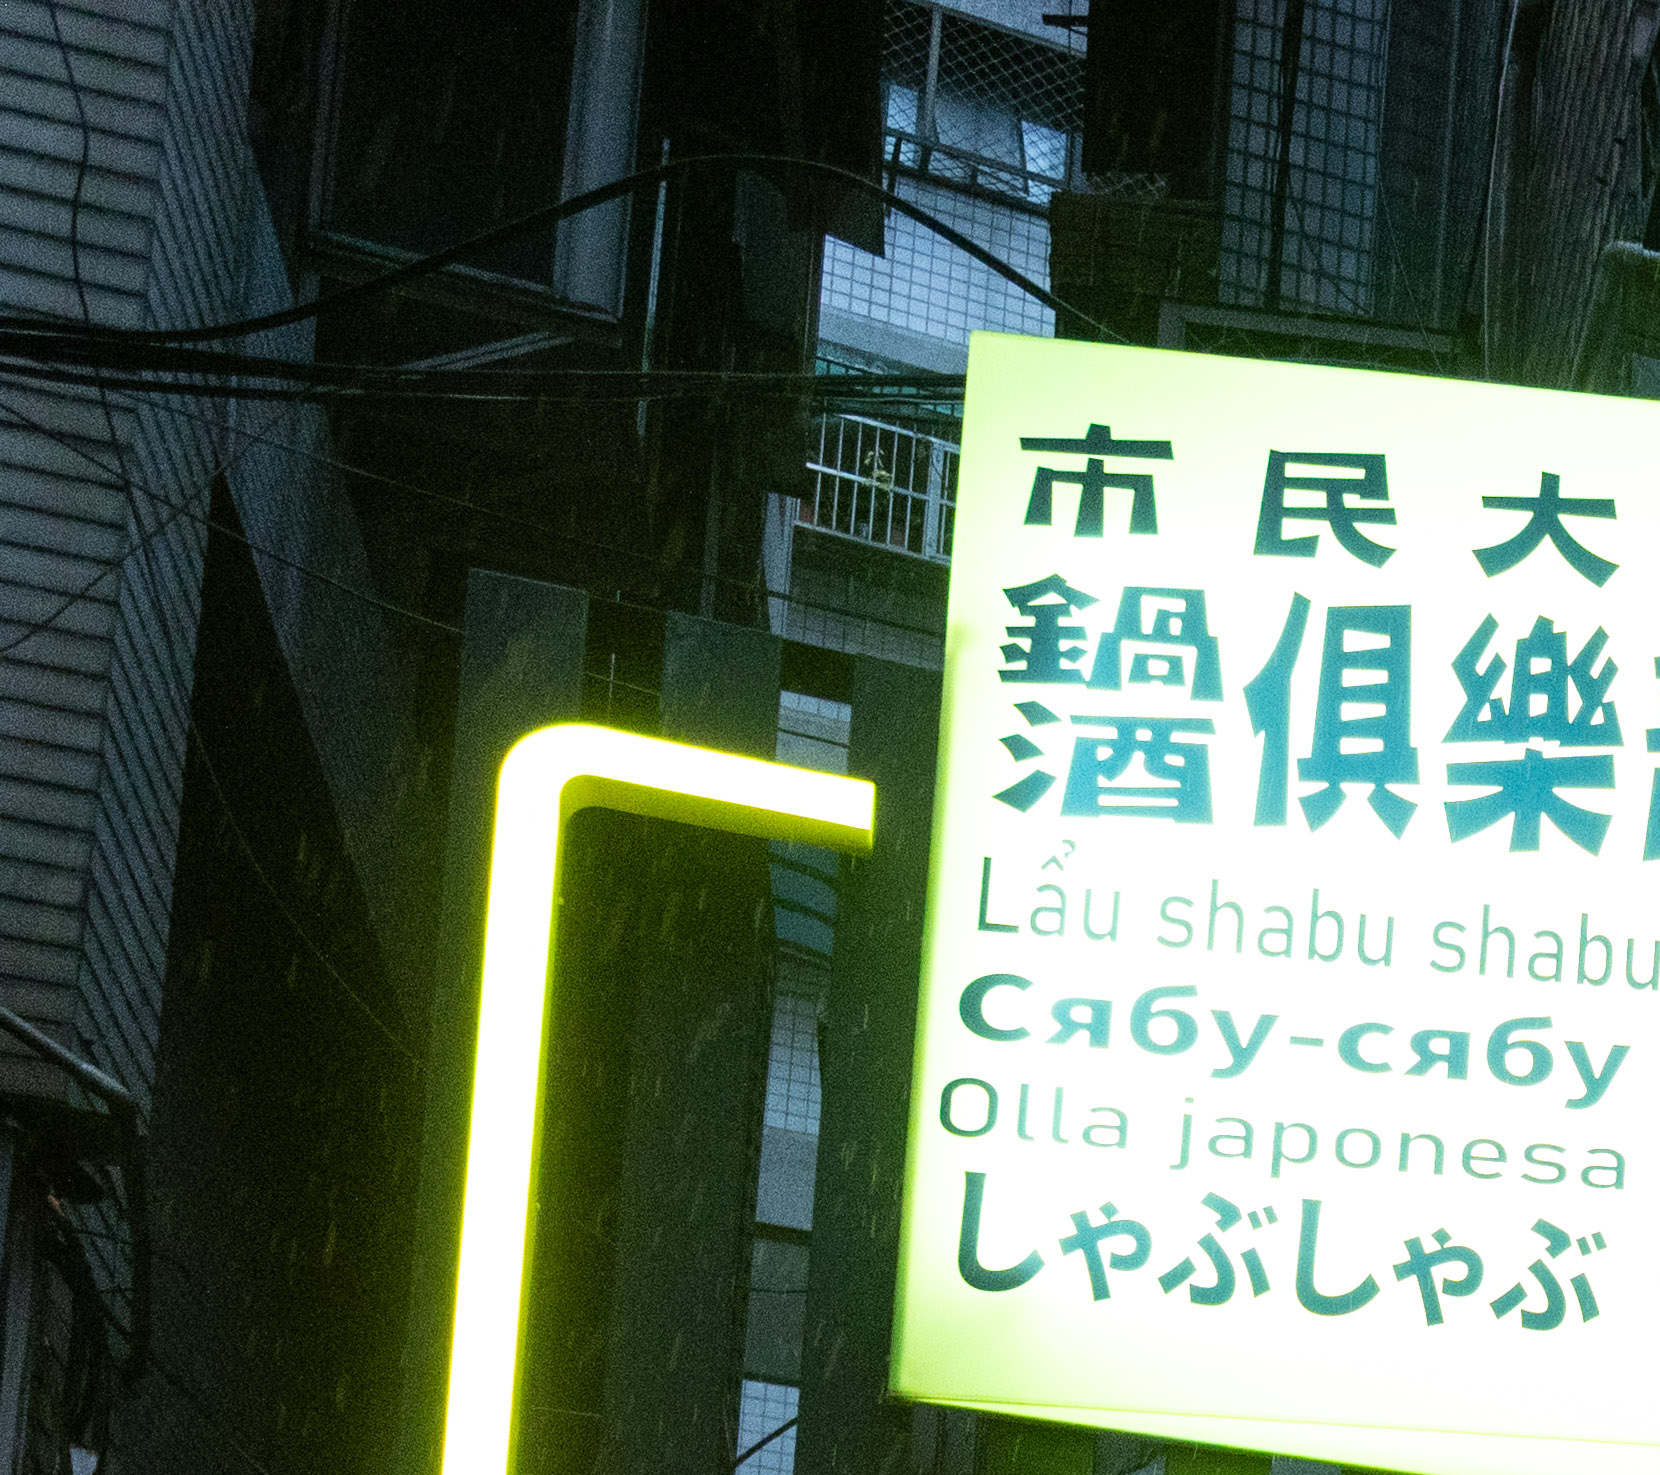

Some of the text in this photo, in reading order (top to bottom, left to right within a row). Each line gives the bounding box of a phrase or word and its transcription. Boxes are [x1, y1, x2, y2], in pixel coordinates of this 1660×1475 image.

[977, 840, 1120, 942] Lẩu
[1157, 879, 1394, 967] shabu
[958, 973, 1631, 1110] Сябу-сябу
[939, 1077, 1626, 1190] Olla japonesa
[957, 1171, 1607, 1331] しゃぶしゃぶ
